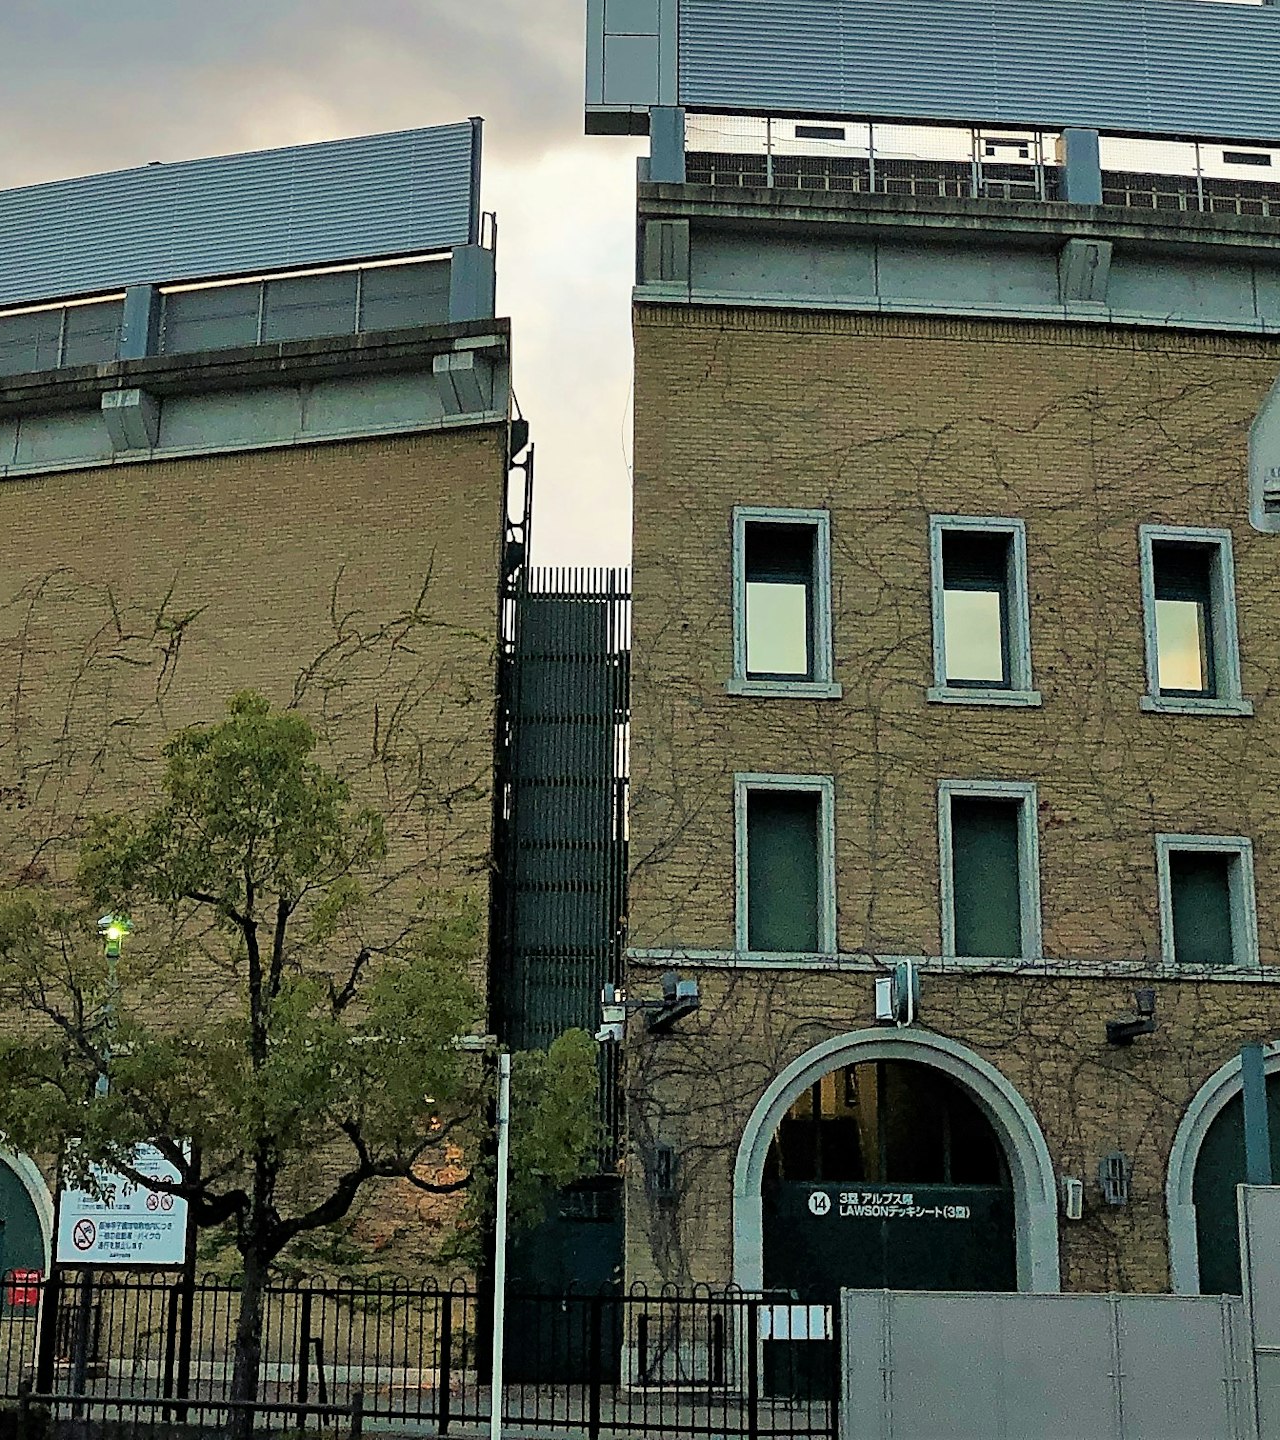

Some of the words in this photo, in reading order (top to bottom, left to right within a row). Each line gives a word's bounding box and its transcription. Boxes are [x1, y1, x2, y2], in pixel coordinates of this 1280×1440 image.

[861, 1193, 914, 1205] アルプス席
